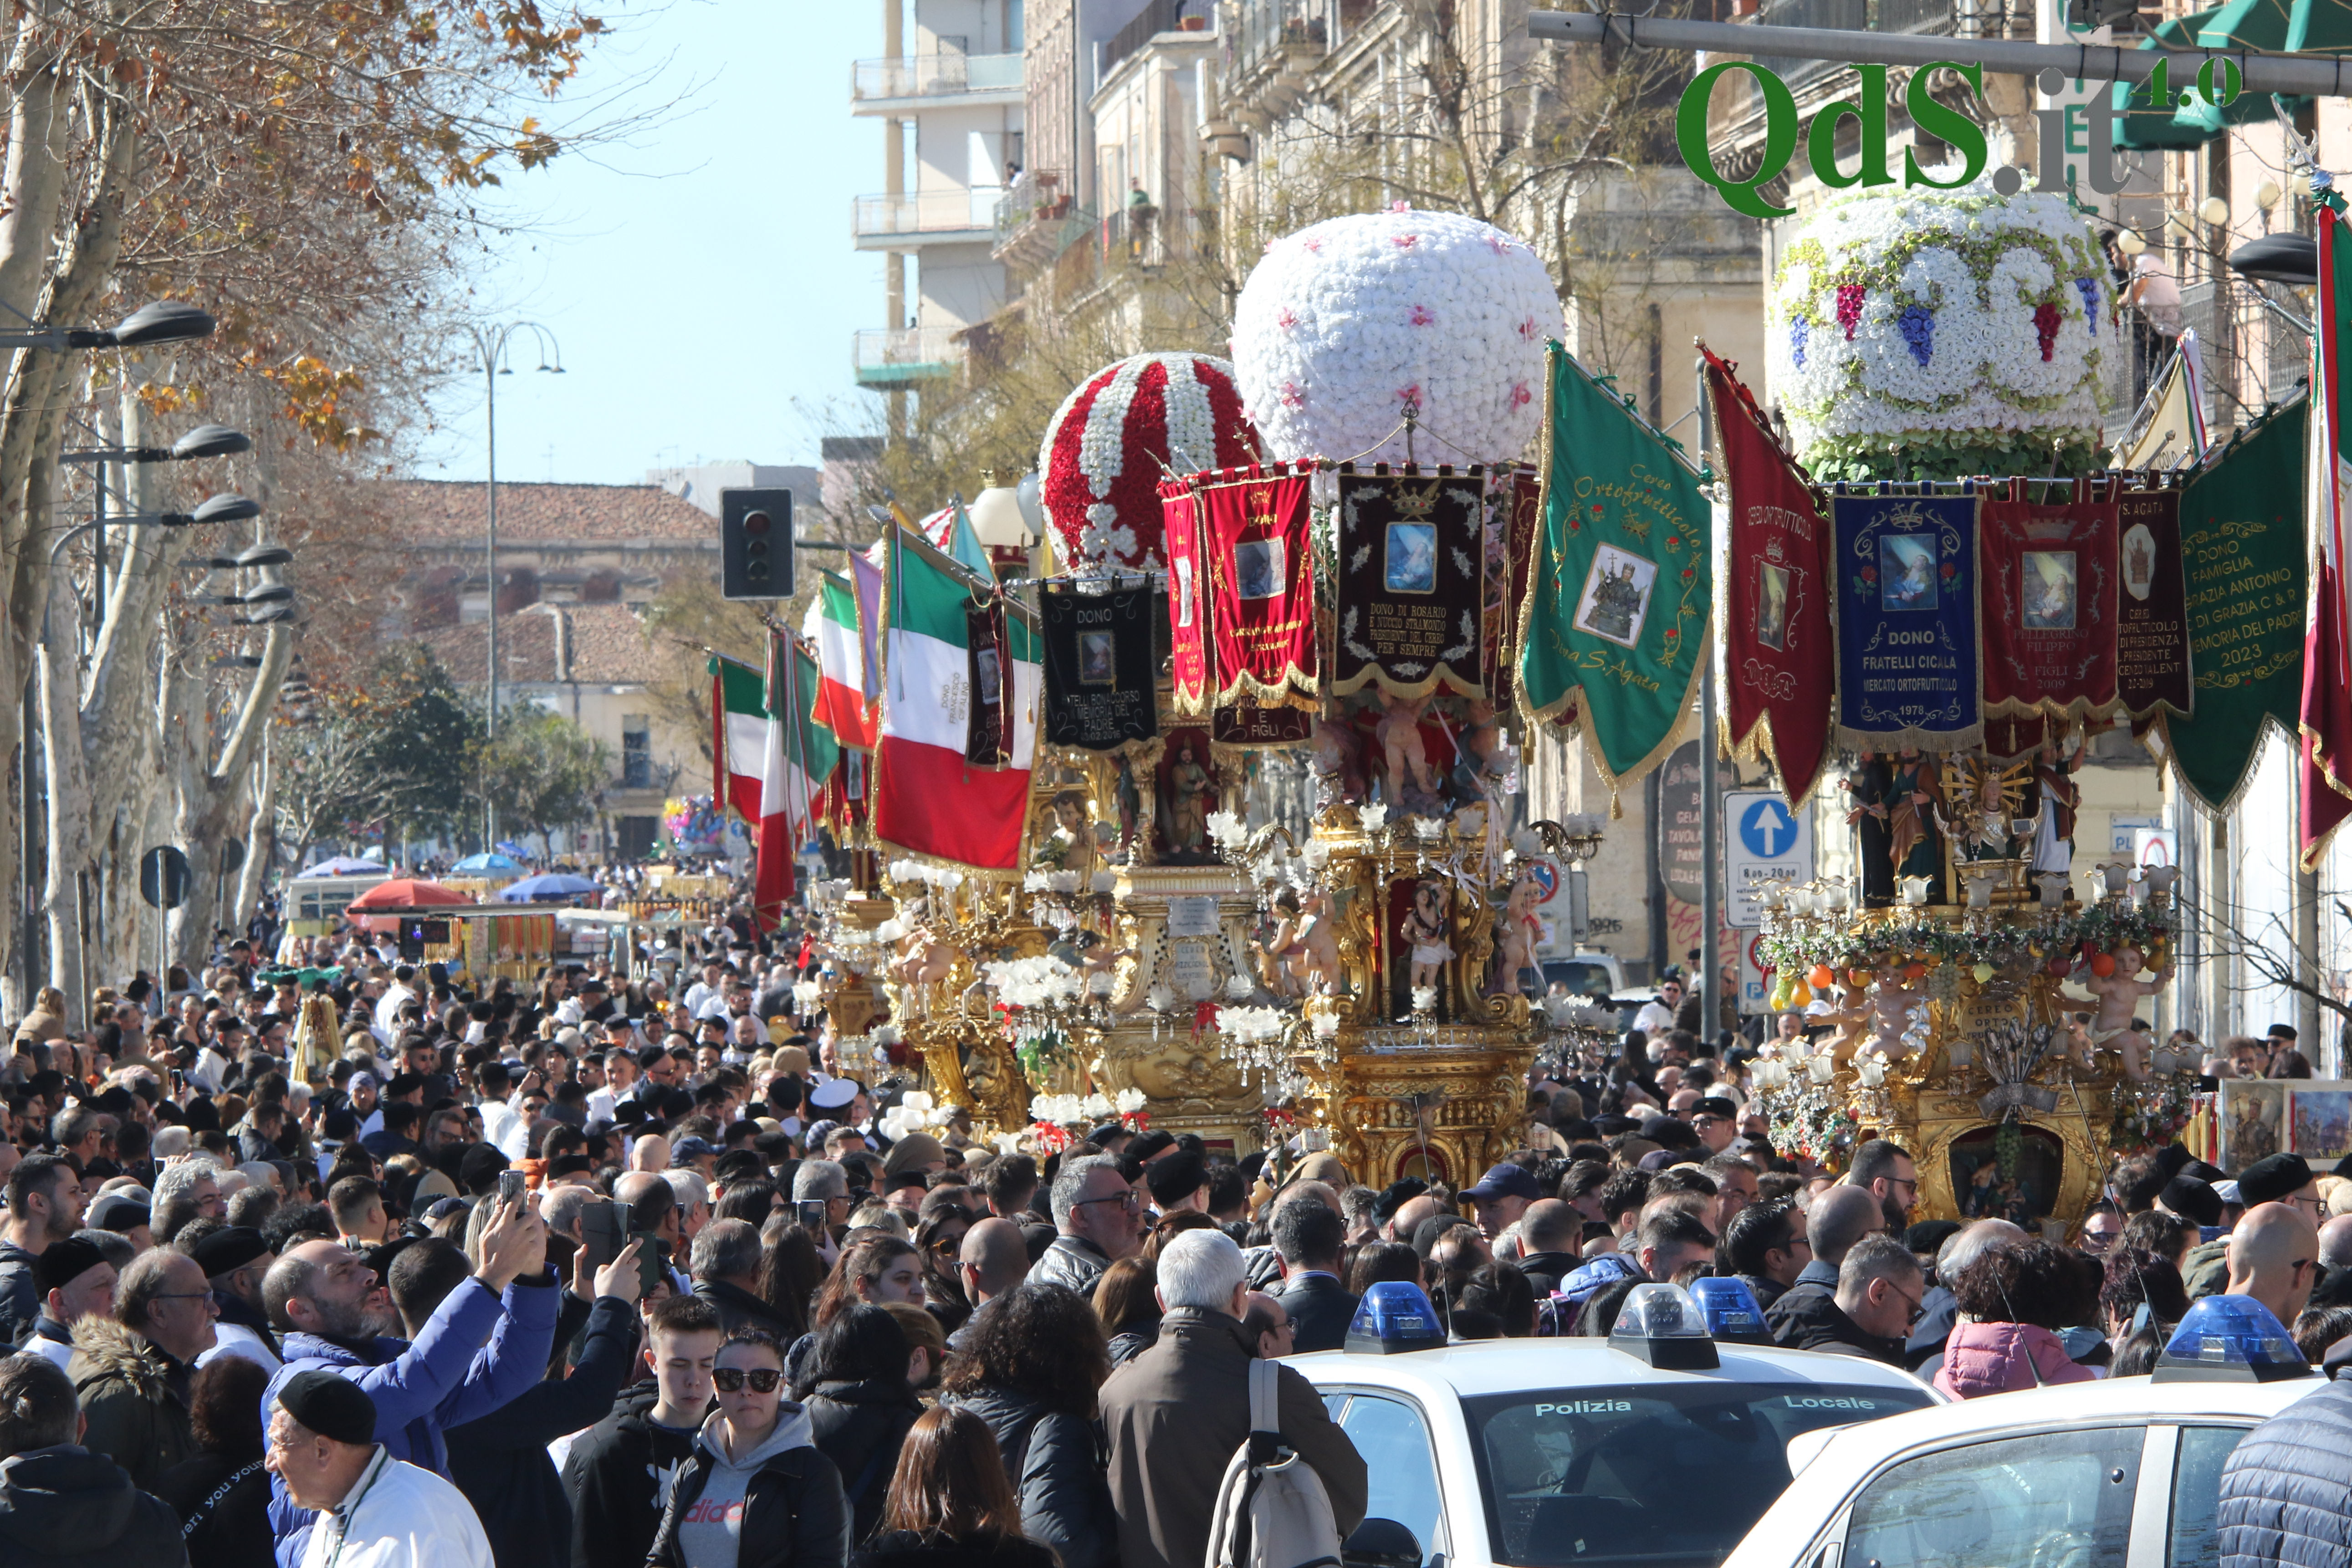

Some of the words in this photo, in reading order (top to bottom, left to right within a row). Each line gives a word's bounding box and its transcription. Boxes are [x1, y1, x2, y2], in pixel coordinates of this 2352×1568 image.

[1630, 464, 1671, 490] Cereo
[1575, 476, 1701, 547] Ortofrutticolo
[2133, 502, 2163, 515] AGATA
[2198, 541, 2239, 563] DONO
[2192, 556, 2254, 584] FAMIGLIA
[2231, 568, 2291, 596] ANTONIO
[1077, 608, 1112, 623] DONO
[1370, 603, 1393, 615] DONO
[1398, 605, 1406, 616] DI
[1412, 606, 1447, 618] ROSARIO
[2196, 613, 2209, 628] DI
[2212, 600, 2259, 623] GRAZIA
[2260, 596, 2271, 609] C
[1370, 617, 1375, 627] E
[1406, 618, 1446, 631] STRAMONDO
[2242, 622, 2265, 638] DEL
[1410, 631, 1421, 643] DEL
[1425, 632, 1444, 644] CEREO
[1888, 631, 1935, 645] DONO
[2014, 628, 2088, 639] PELLEGRINO
[1376, 642, 1395, 654] PER
[1400, 644, 1436, 657] SEMPRE
[2027, 641, 2076, 652] FILIPPO
[1863, 656, 1915, 670] FRATELLI
[1918, 655, 1957, 669] CICALA
[2047, 654, 2055, 664] E
[2221, 644, 2262, 667] 2023
[2035, 666, 2068, 676] FIGLI
[1863, 679, 1895, 692] MERCATO
[2037, 679, 2066, 689] 2009
[941, 684, 950, 708] DONO
[949, 673, 960, 724] FRANCESCO
[1115, 704, 1130, 717] DEL
[1258, 711, 1267, 723] E
[1899, 705, 1924, 715] 1978
[1084, 718, 1115, 731] PADRE
[1252, 725, 1278, 736] FIGLI
[1968, 1004, 2013, 1015] CEREO
[1535, 1399, 1632, 1417] Polizia
[1783, 1395, 1876, 1410] Locale
[205, 1481, 232, 1509] you
